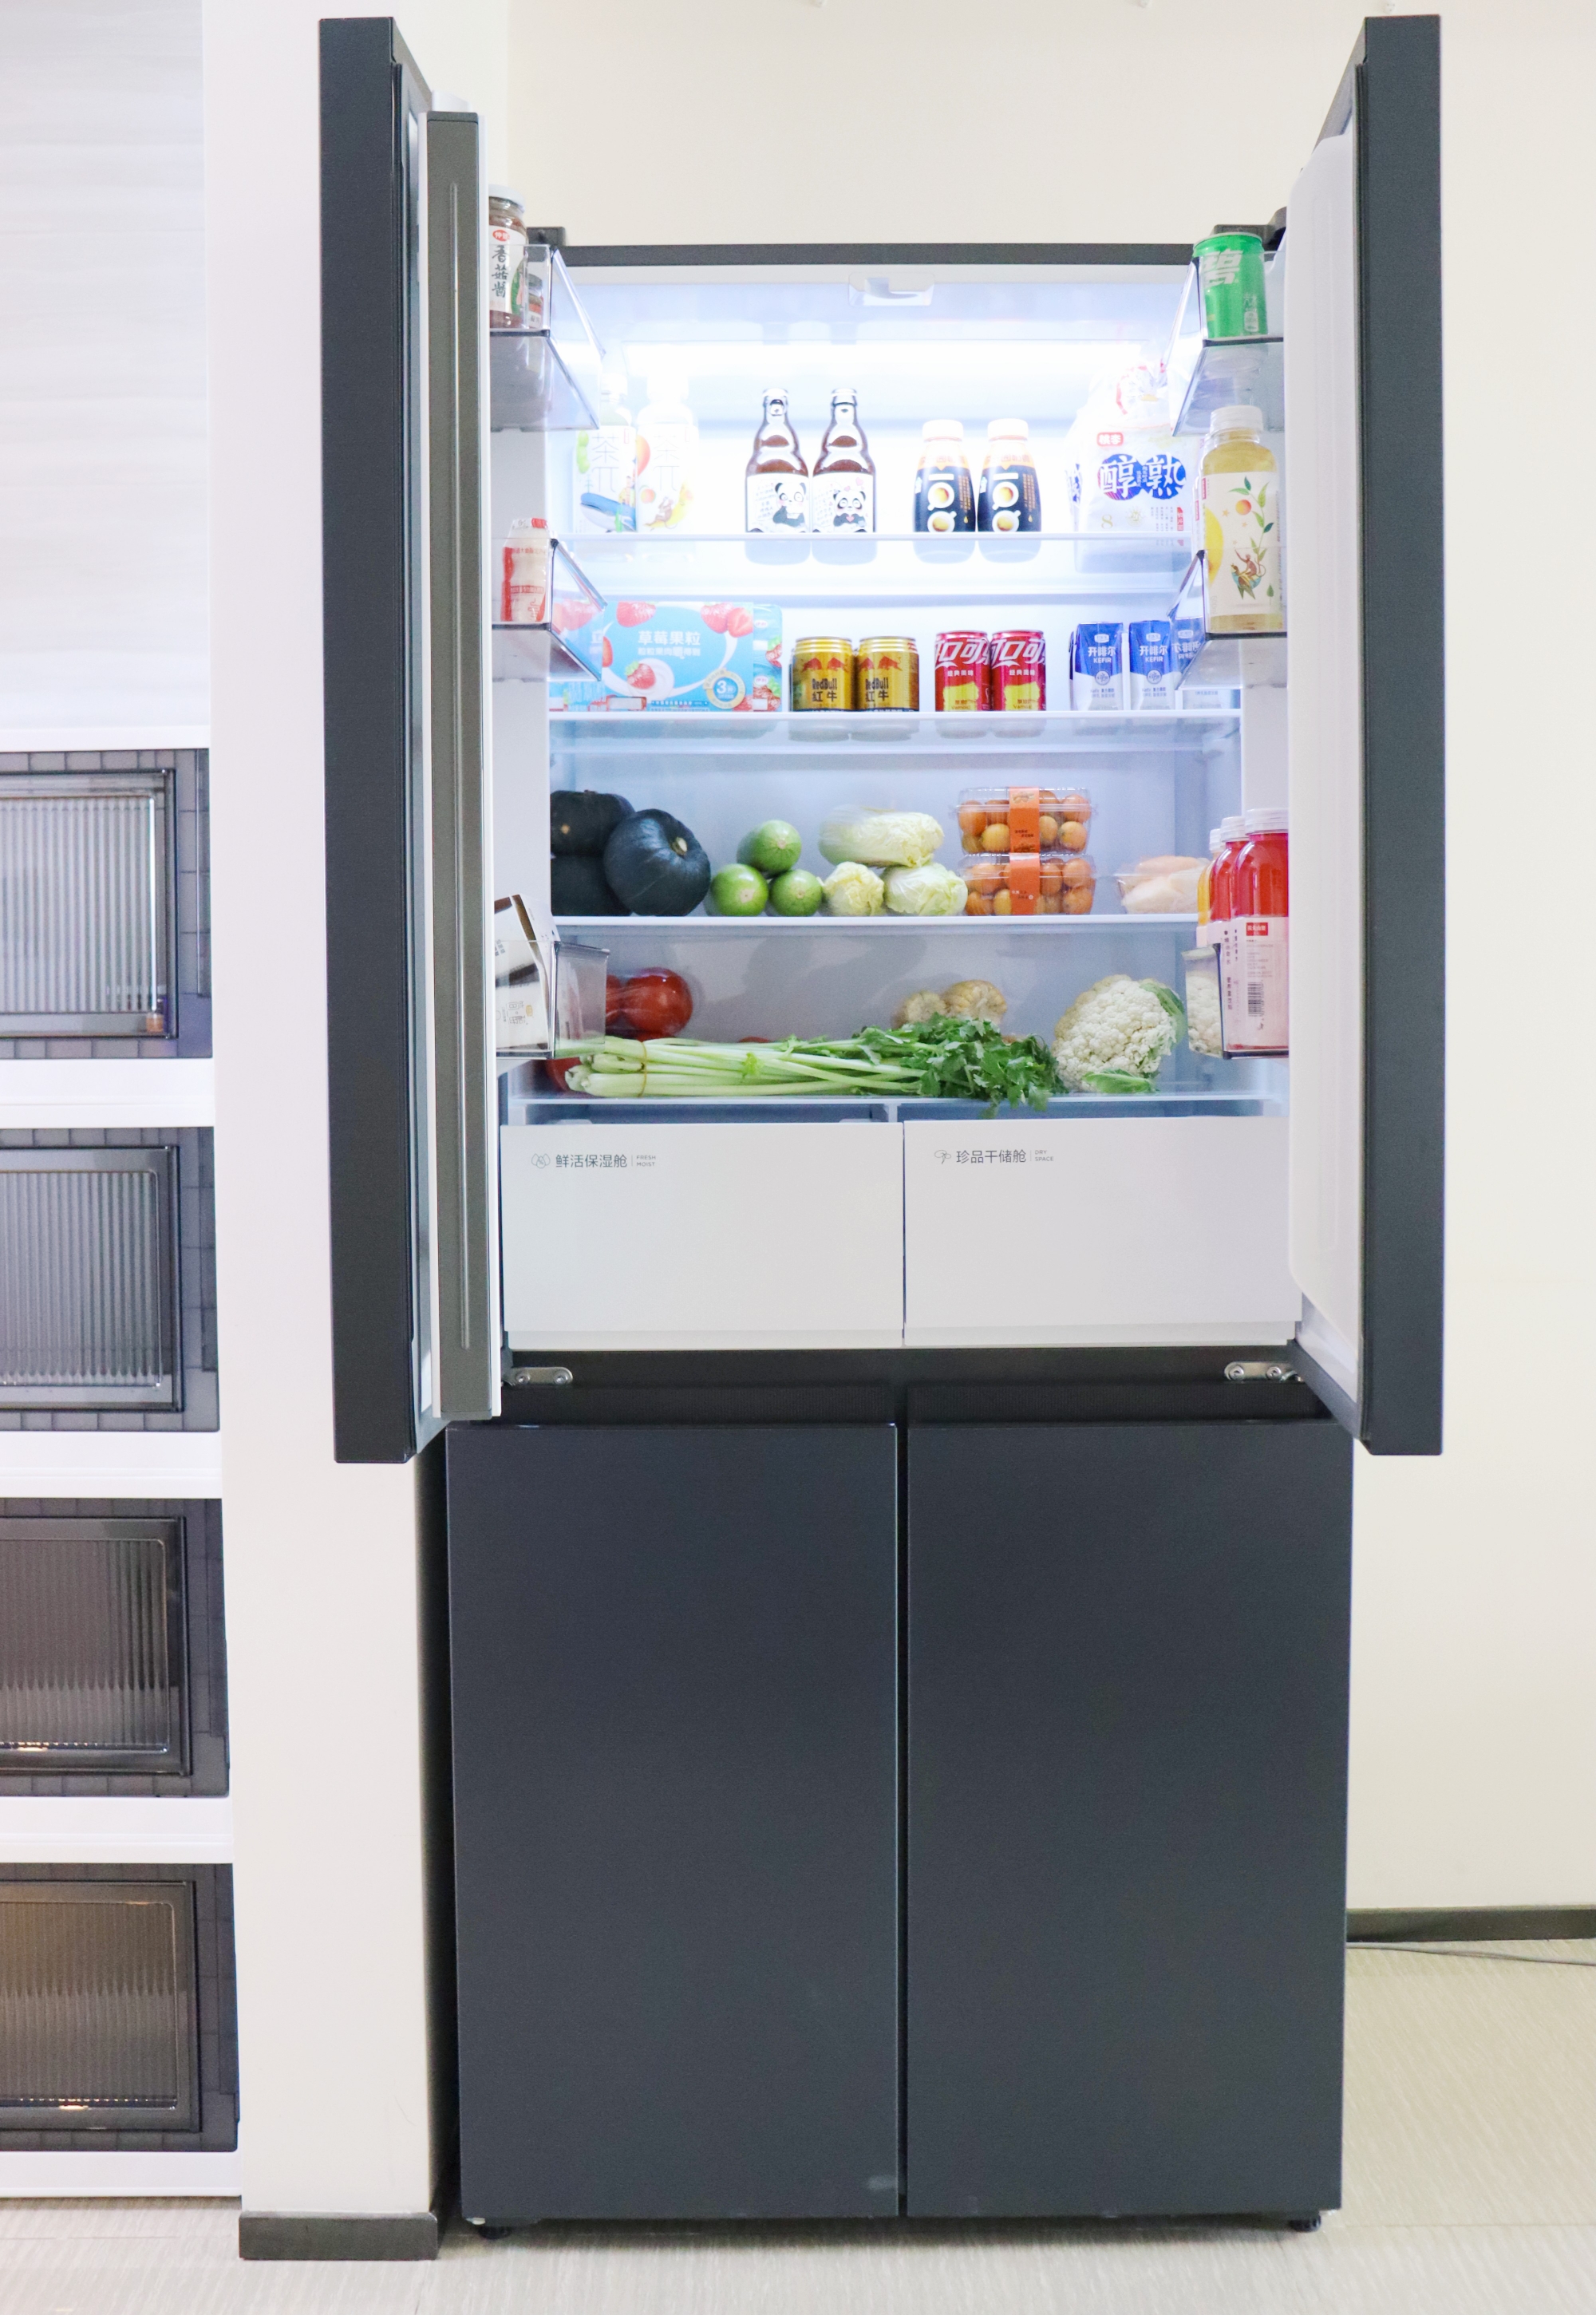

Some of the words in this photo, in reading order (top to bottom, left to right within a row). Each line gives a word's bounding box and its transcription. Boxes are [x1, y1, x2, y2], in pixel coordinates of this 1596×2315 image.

[1100, 452, 1187, 498] 醇熟
[638, 630, 701, 646] 草莓果粒
[1088, 646, 1116, 658] 开啡尔
[1140, 645, 1167, 657] 开啡尔
[555, 1154, 628, 1168] 鲜活保湿舱
[956, 1149, 1026, 1163] 珍品干储舱
